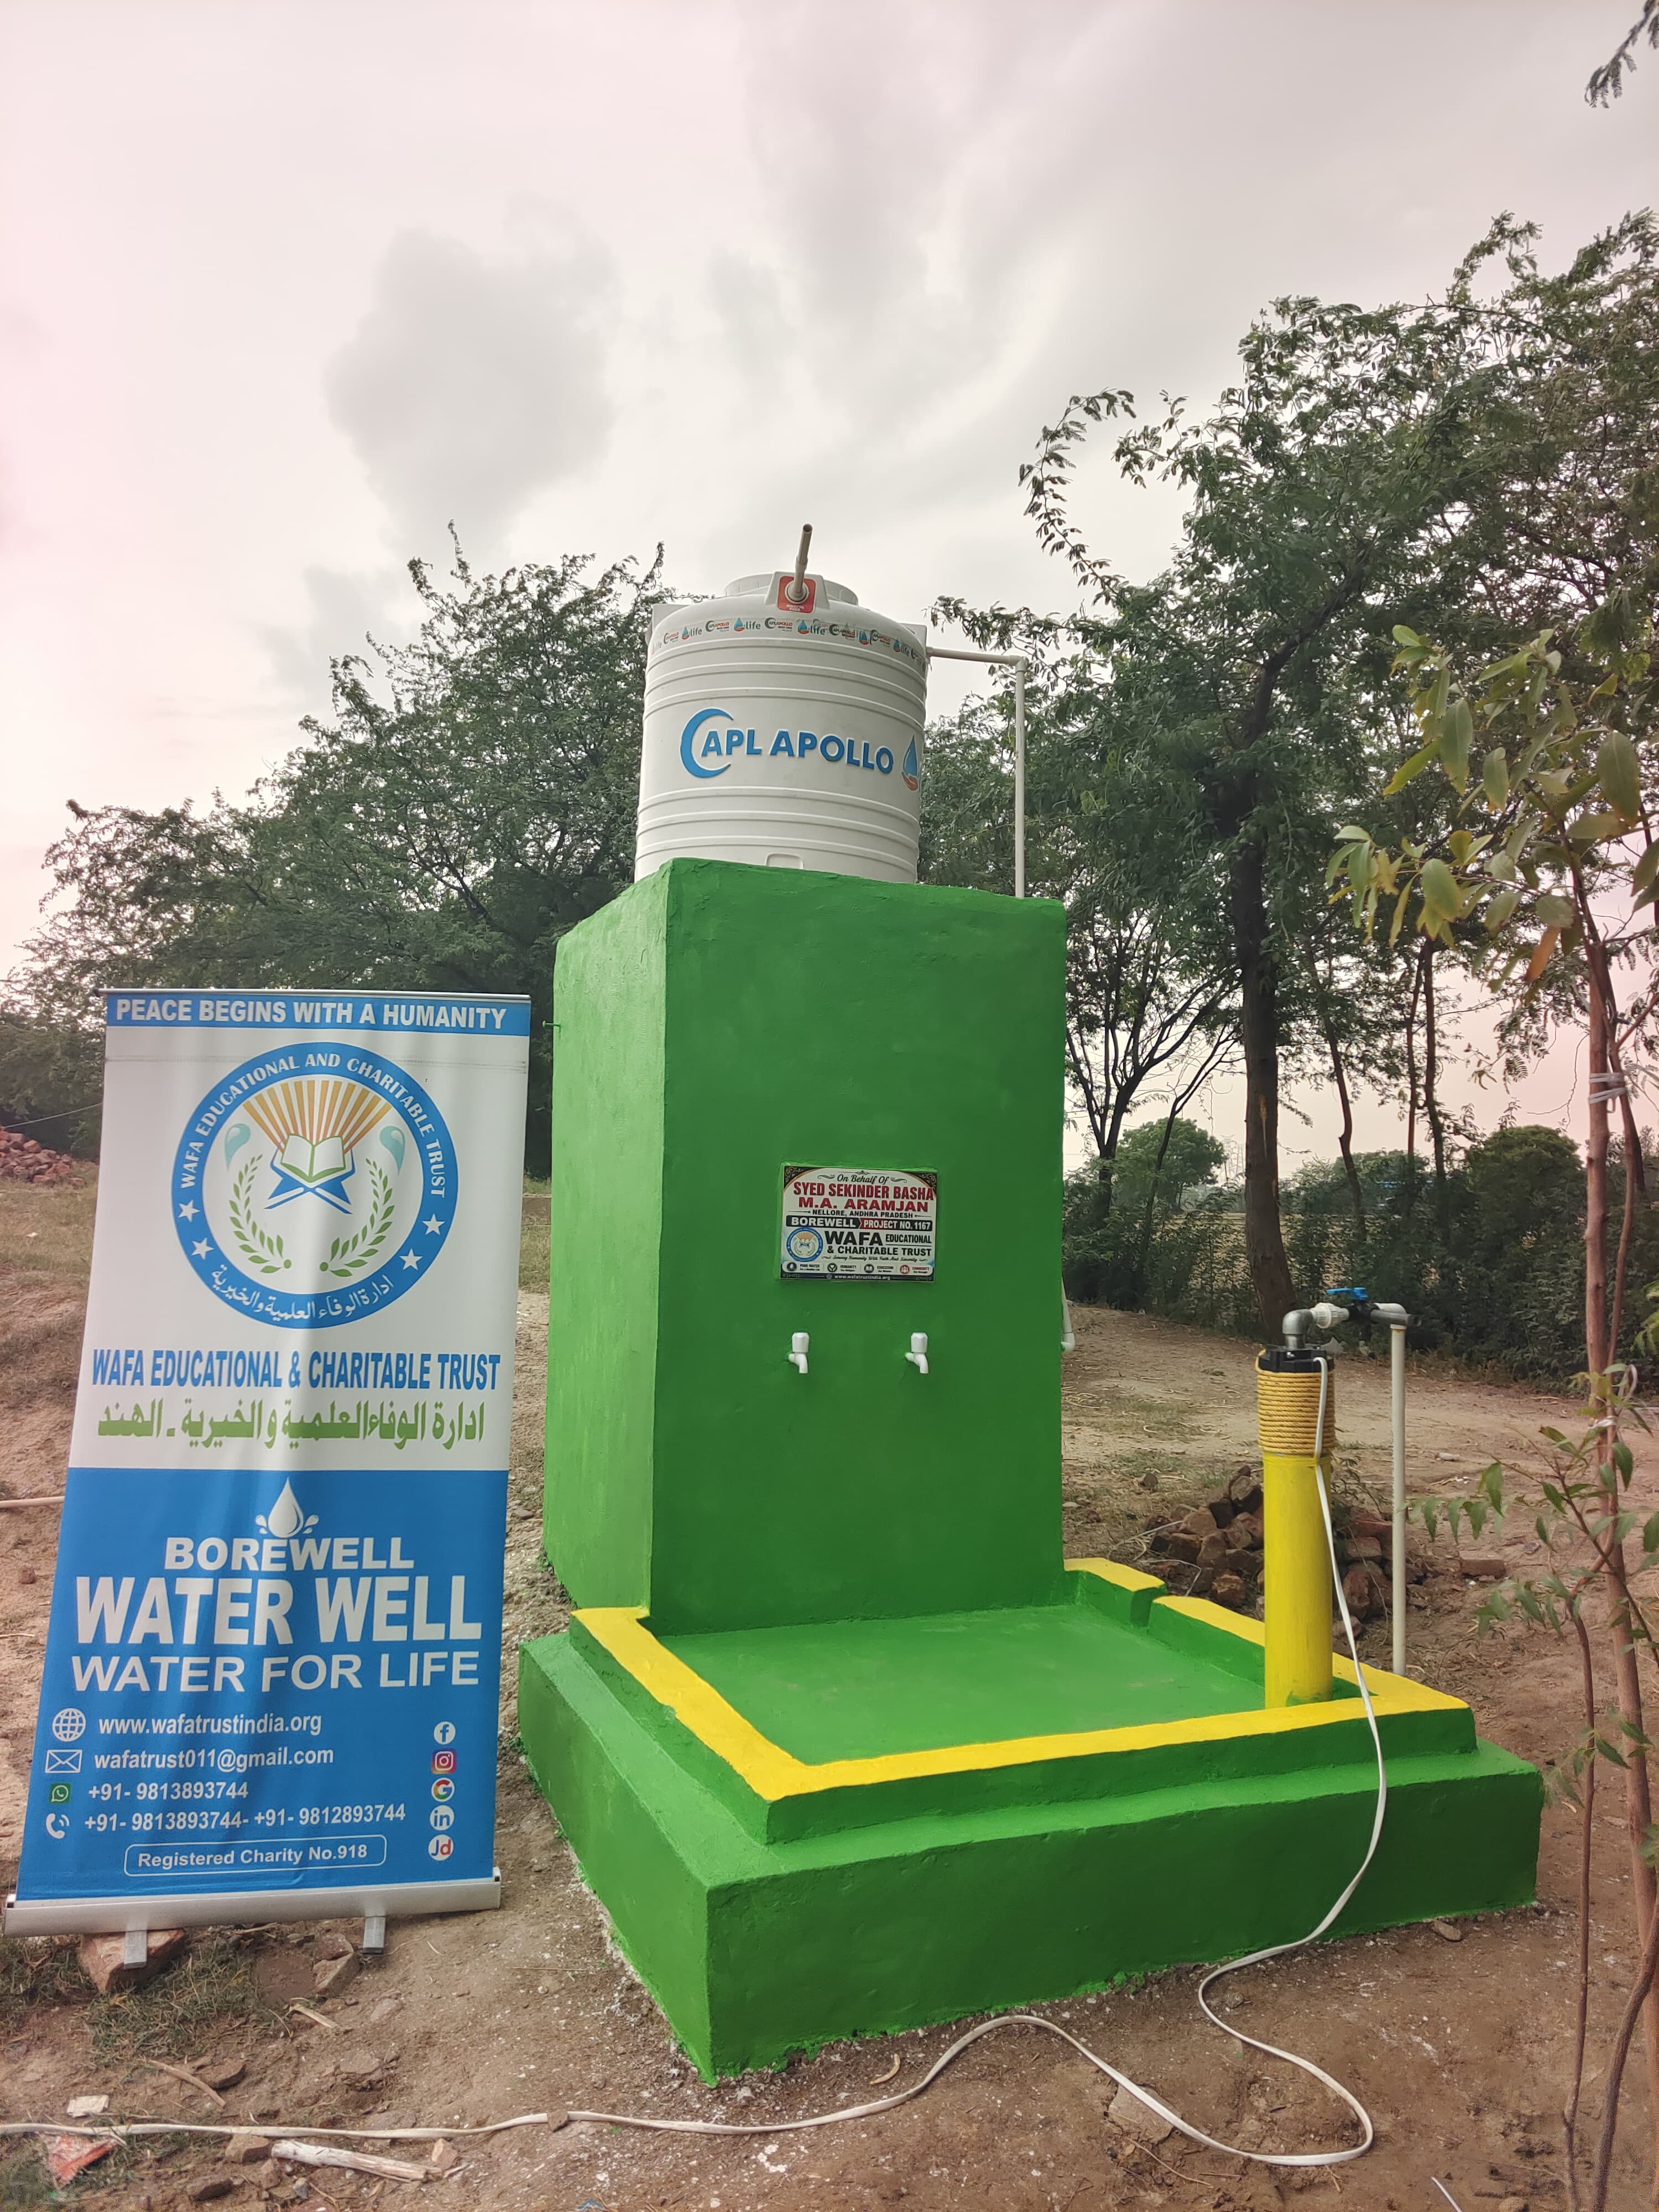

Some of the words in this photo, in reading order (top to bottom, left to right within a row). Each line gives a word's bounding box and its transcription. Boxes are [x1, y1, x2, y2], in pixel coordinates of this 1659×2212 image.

[747, 621, 761, 630] life
[769, 729, 894, 774] APOLLO
[116, 999, 192, 1021] PEACE
[198, 1000, 286, 1023] BEGINS
[292, 1002, 353, 1024] WITH
[359, 1003, 376, 1025] A
[383, 1004, 507, 1029] HUMANITY
[180, 1141, 204, 1188] WAFA
[195, 1055, 300, 1137] EDUCATIONAL
[305, 1053, 341, 1068] AND
[346, 1057, 436, 1138] CHARITABLE
[425, 1138, 447, 1198] TRUST
[794, 1181, 825, 1196] SYED
[828, 1183, 890, 1199] SEKINDER
[893, 1186, 934, 1201] BASHA
[851, 1175, 877, 1185] Behalf
[878, 1176, 889, 1185] Of
[799, 1197, 837, 1209] M.A.
[844, 1198, 928, 1212] ARAMJAN
[791, 1217, 856, 1227] BOREWELL
[863, 1219, 898, 1229] PROJECT
[899, 1221, 912, 1229] NO.
[914, 1222, 931, 1230] 1167
[825, 1230, 883, 1246] WAFA
[885, 1234, 932, 1244] EDUCATIONAL
[827, 1245, 834, 1254] &
[837, 1246, 899, 1255] CHARITABLE
[901, 1248, 932, 1256] TRUST
[264, 1296, 316, 1321] العلمية
[92, 1349, 144, 1386] WAFA
[151, 1350, 282, 1387] EDUCATIONAL
[288, 1351, 300, 1388] &
[309, 1352, 431, 1389] CHARITABLE
[437, 1353, 501, 1390] TRUST
[98, 1398, 163, 1437] الهند
[281, 1398, 369, 1449] العلمية
[164, 1537, 414, 1571] BOREWELL
[76, 1576, 294, 1645] WATER
[315, 1575, 482, 1642] WELL
[72, 1656, 245, 1692] WATER
[261, 1655, 362, 1692] FOR
[379, 1651, 479, 1687] LIFE
[99, 1713, 322, 1736] www.wafatrustindia.org
[95, 1747, 334, 1772] wafatrust011@gmail.com
[88, 1783, 131, 1801] +91-
[136, 1781, 249, 1799] 9813893744
[85, 1813, 126, 1832] +91-
[132, 1811, 249, 1831] 9813893744-
[254, 1808, 294, 1826] +91-
[299, 1803, 406, 1825] 9812893744
[138, 1850, 234, 1870] Registered
[240, 1848, 303, 1865] Charity
[309, 1844, 368, 1861] No.918
